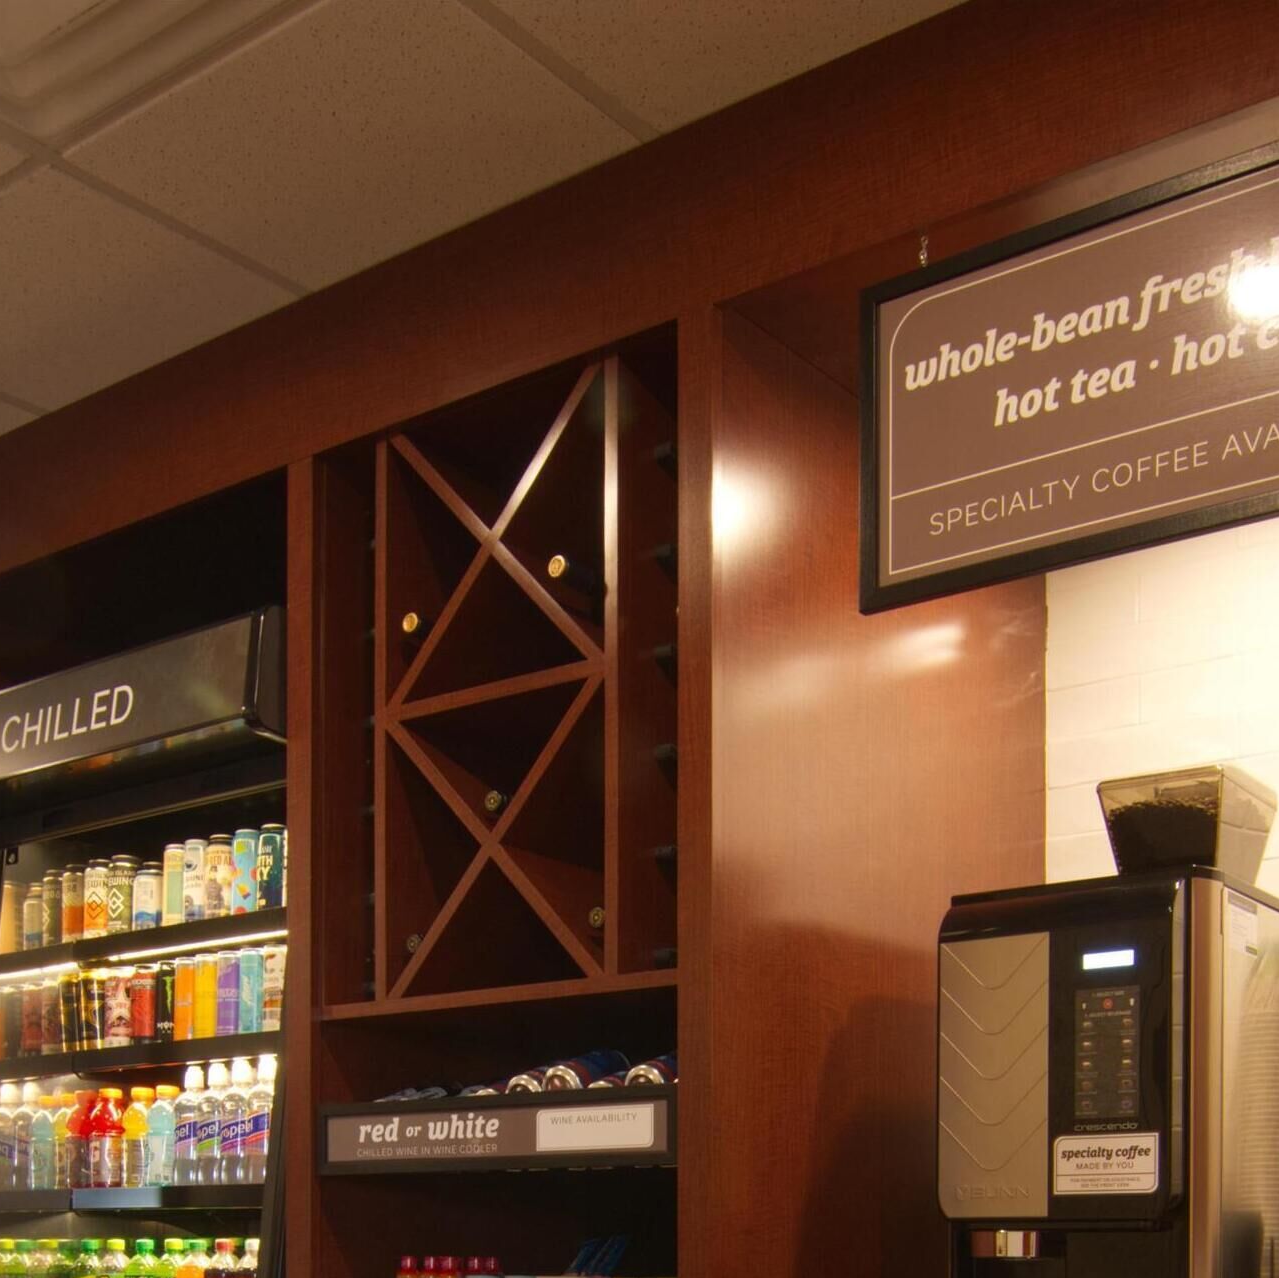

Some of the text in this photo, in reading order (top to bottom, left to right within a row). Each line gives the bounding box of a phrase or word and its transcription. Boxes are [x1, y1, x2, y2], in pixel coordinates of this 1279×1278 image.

[903, 292, 1132, 393] whole-bean
[993, 376, 1059, 427] hot
[1070, 358, 1137, 404] tea
[1171, 322, 1247, 376] hot
[928, 476, 1083, 537] SPECIALTY
[1091, 441, 1210, 492] COFFEE
[0, 684, 134, 754] CHILLED
[359, 1113, 501, 1143] red or white
[550, 1112, 638, 1126] WINE AVAILABILITY
[356, 1143, 499, 1158] CHILLED WINE IN WINE COOLER
[1061, 1145, 1151, 1162] specialty coffee
[1075, 1161, 1134, 1170] MADE BY YOU
